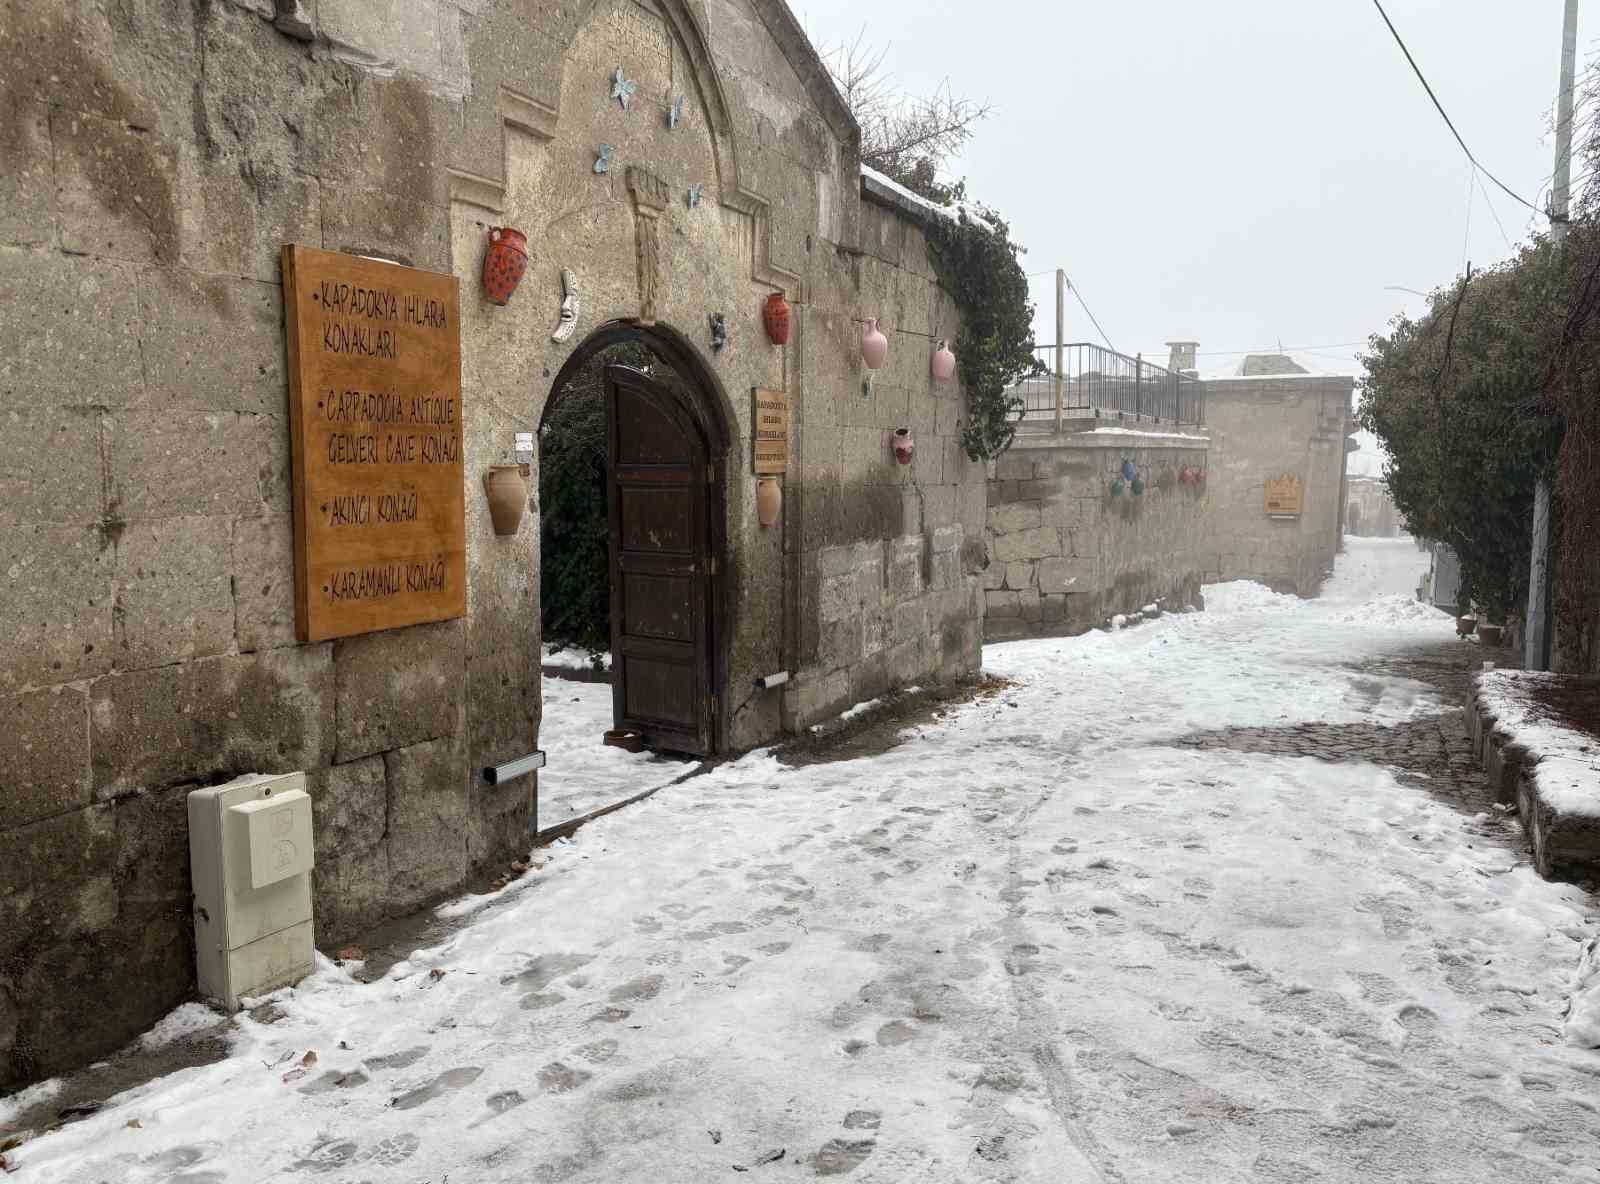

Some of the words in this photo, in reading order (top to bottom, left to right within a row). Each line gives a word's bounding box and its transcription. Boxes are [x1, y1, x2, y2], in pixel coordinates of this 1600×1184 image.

[321, 280, 399, 320] KAPADOKYA
[404, 295, 448, 329] IHLARA
[323, 321, 397, 359] KONAKLARI
[385, 434, 415, 465] CAVE
[330, 493, 371, 527] AKINCI
[329, 564, 400, 602] KARAMANLI
